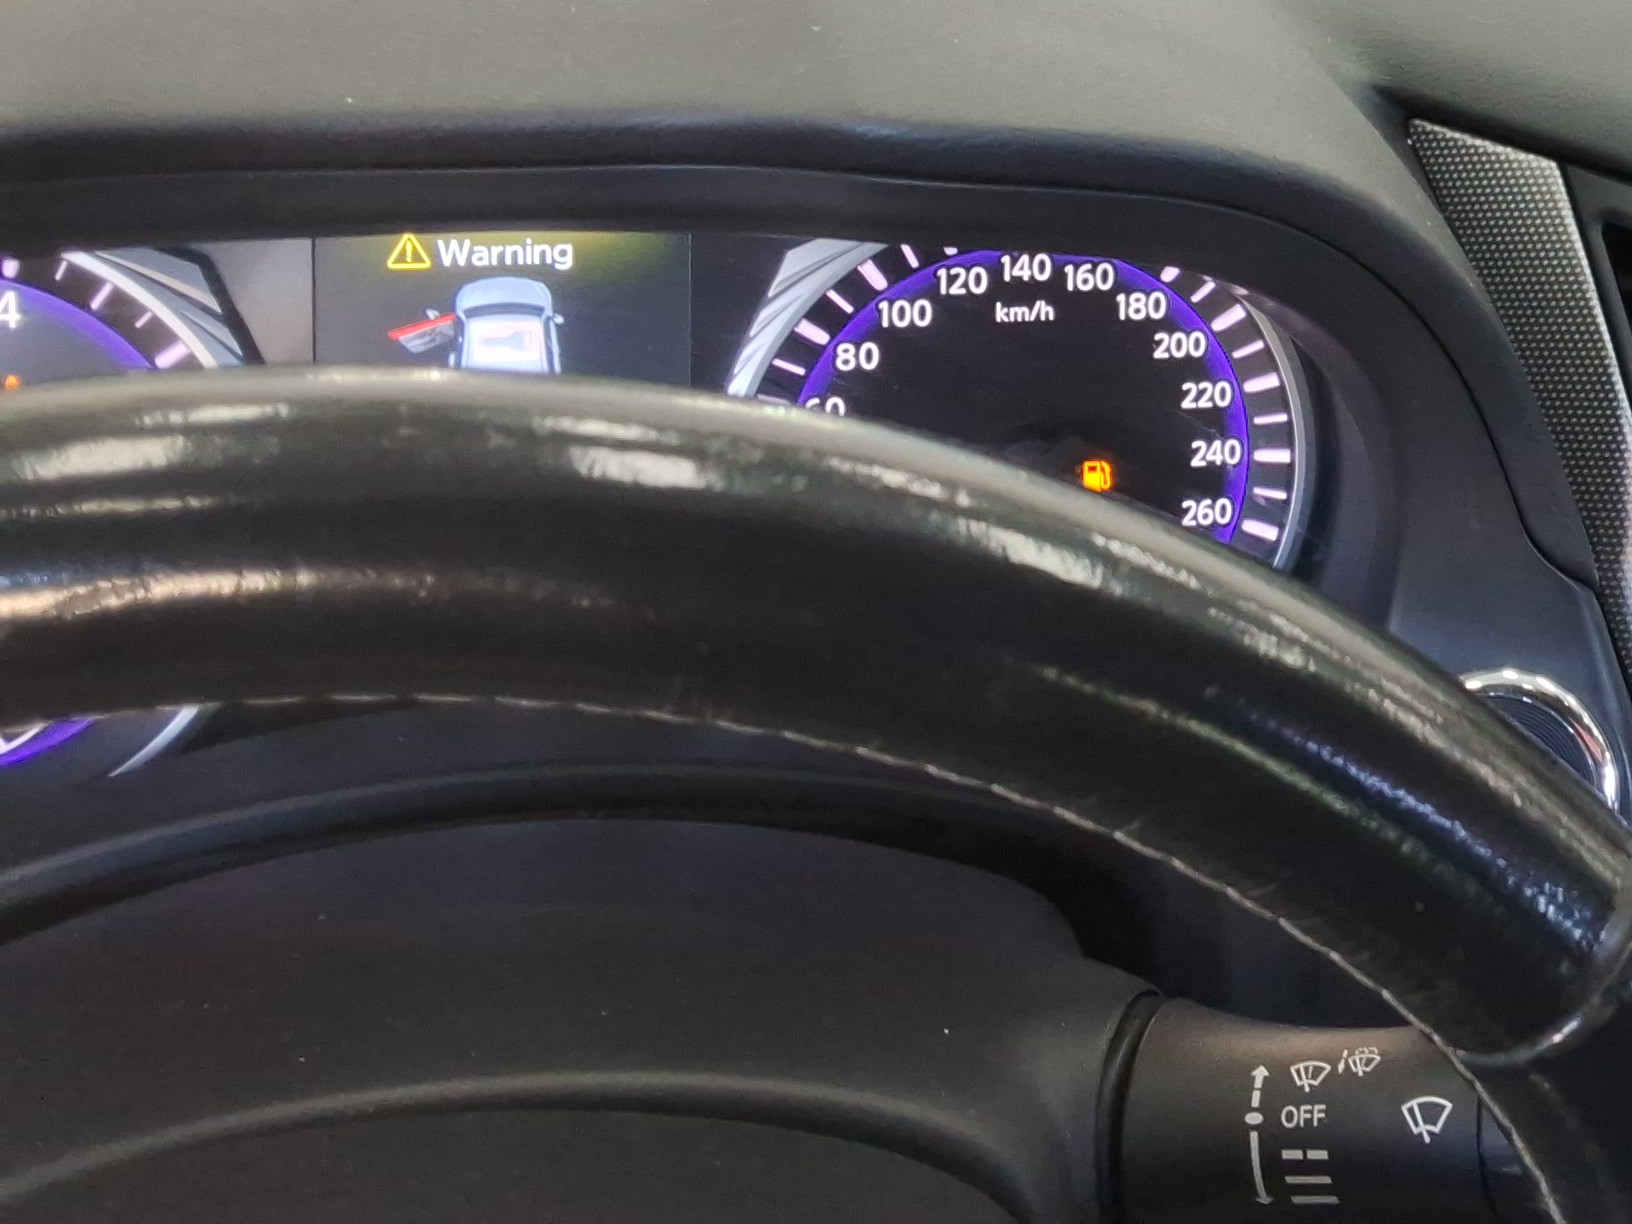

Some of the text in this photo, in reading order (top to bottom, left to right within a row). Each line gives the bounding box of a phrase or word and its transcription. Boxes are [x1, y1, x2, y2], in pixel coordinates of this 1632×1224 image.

[437, 237, 574, 271] Warning
[1001, 253, 1052, 282] 140
[936, 266, 988, 296] 120
[1064, 262, 1115, 292] 160
[0, 290, 21, 329] 4
[878, 298, 933, 328] 100
[995, 300, 1055, 323] km/h
[1116, 291, 1168, 321] 180
[835, 342, 880, 372] 80
[1153, 330, 1207, 360] 200
[1181, 381, 1233, 410] 220
[1190, 438, 1242, 468] 240
[1181, 497, 1233, 527] 260
[1280, 1104, 1327, 1129] OFF
